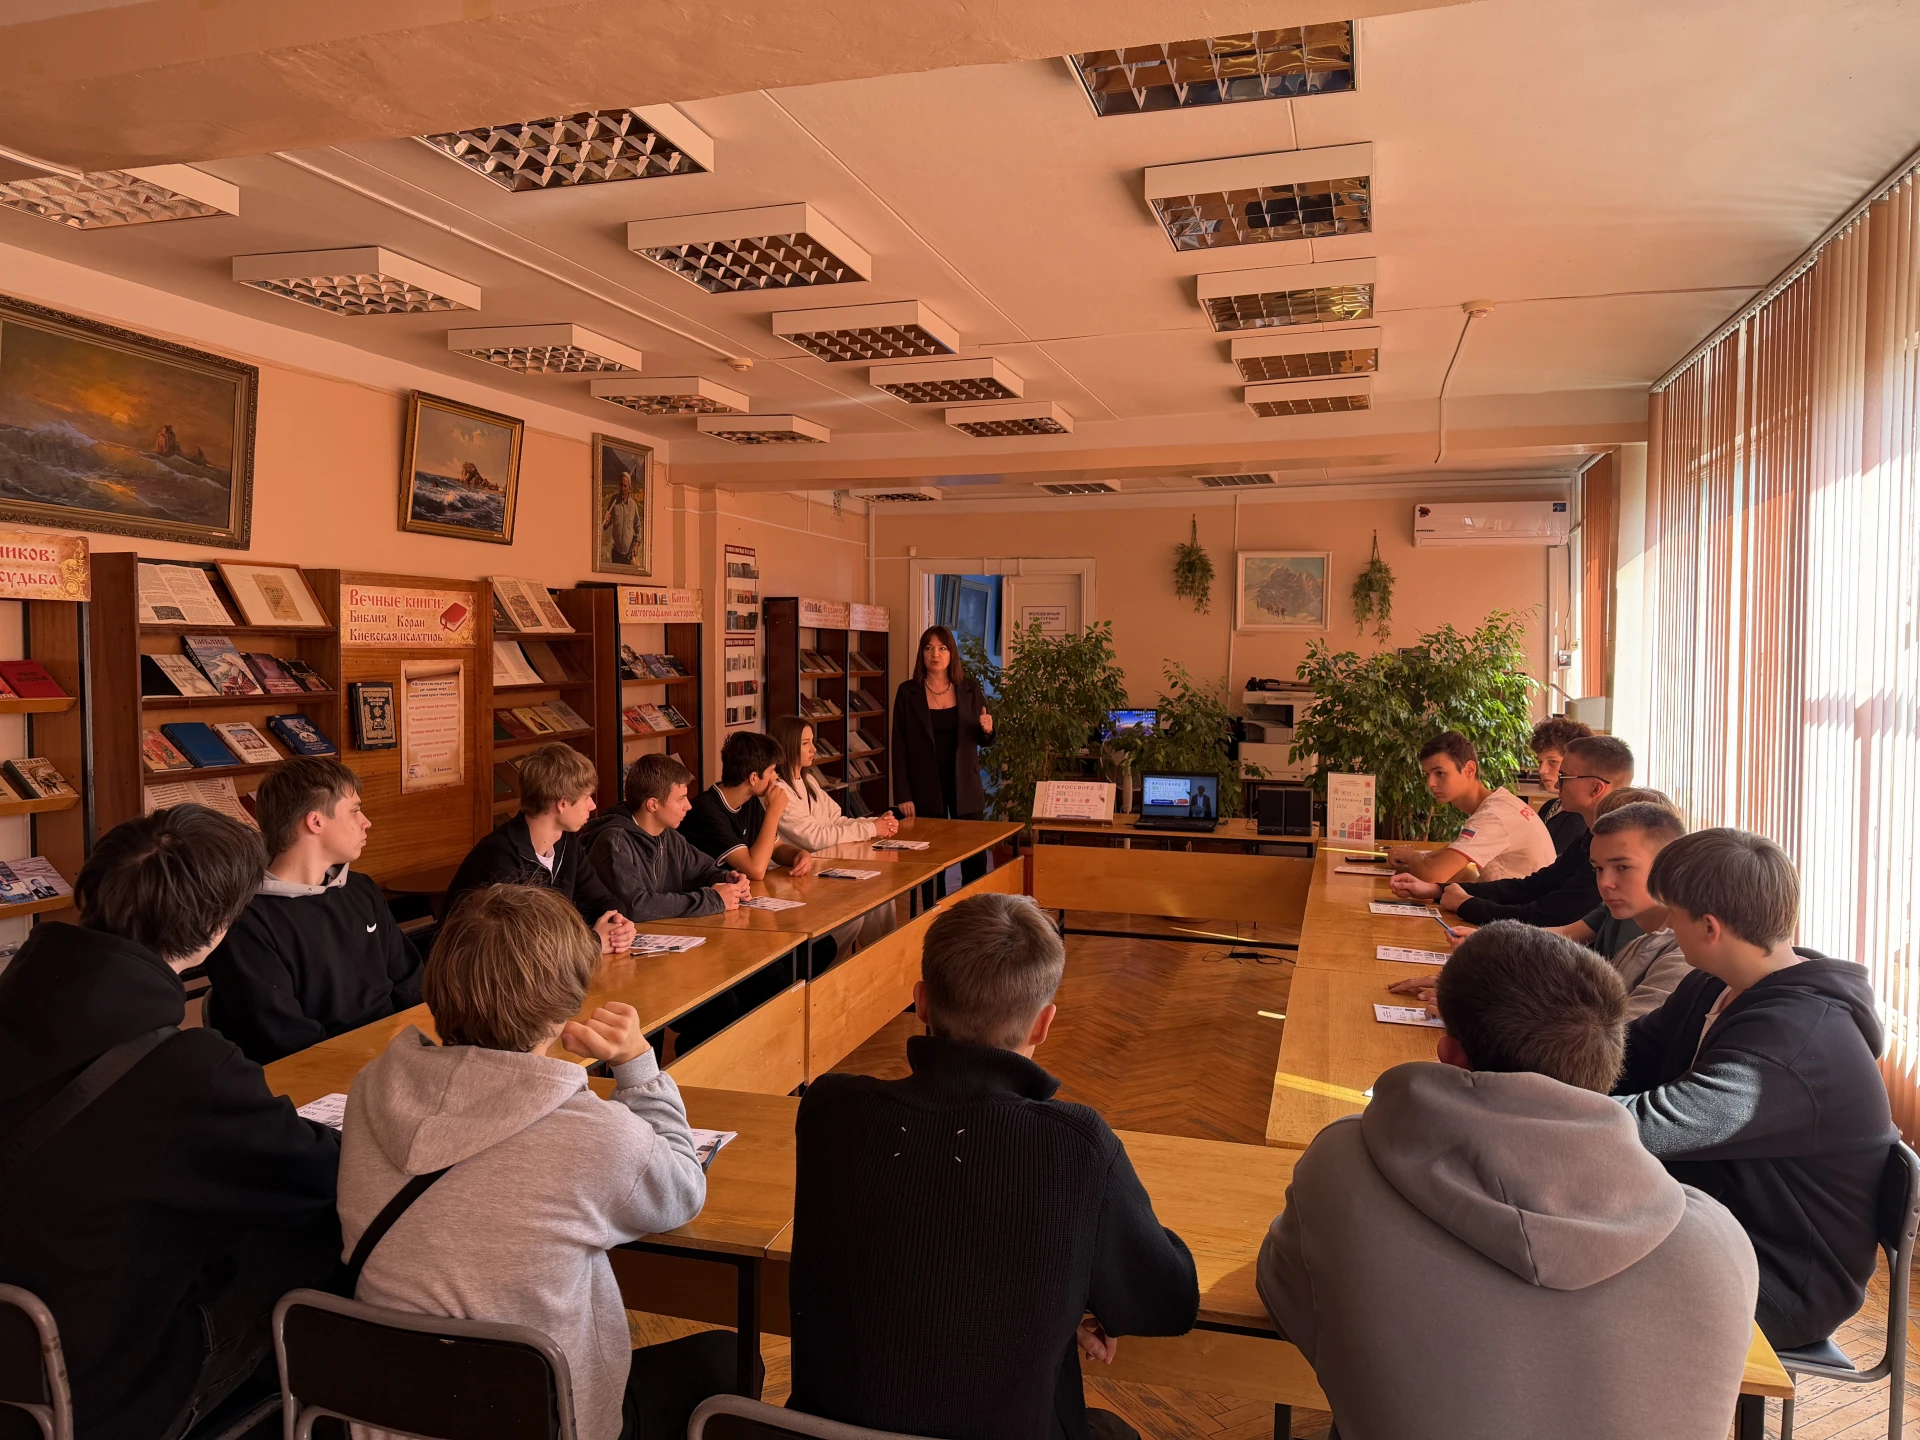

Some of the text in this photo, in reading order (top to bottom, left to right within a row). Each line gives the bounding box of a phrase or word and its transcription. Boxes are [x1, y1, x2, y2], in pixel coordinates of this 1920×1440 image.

[349, 589, 402, 608] Вечные
[349, 610, 425, 631] Библия Коран
[349, 628, 398, 642] Киевская
